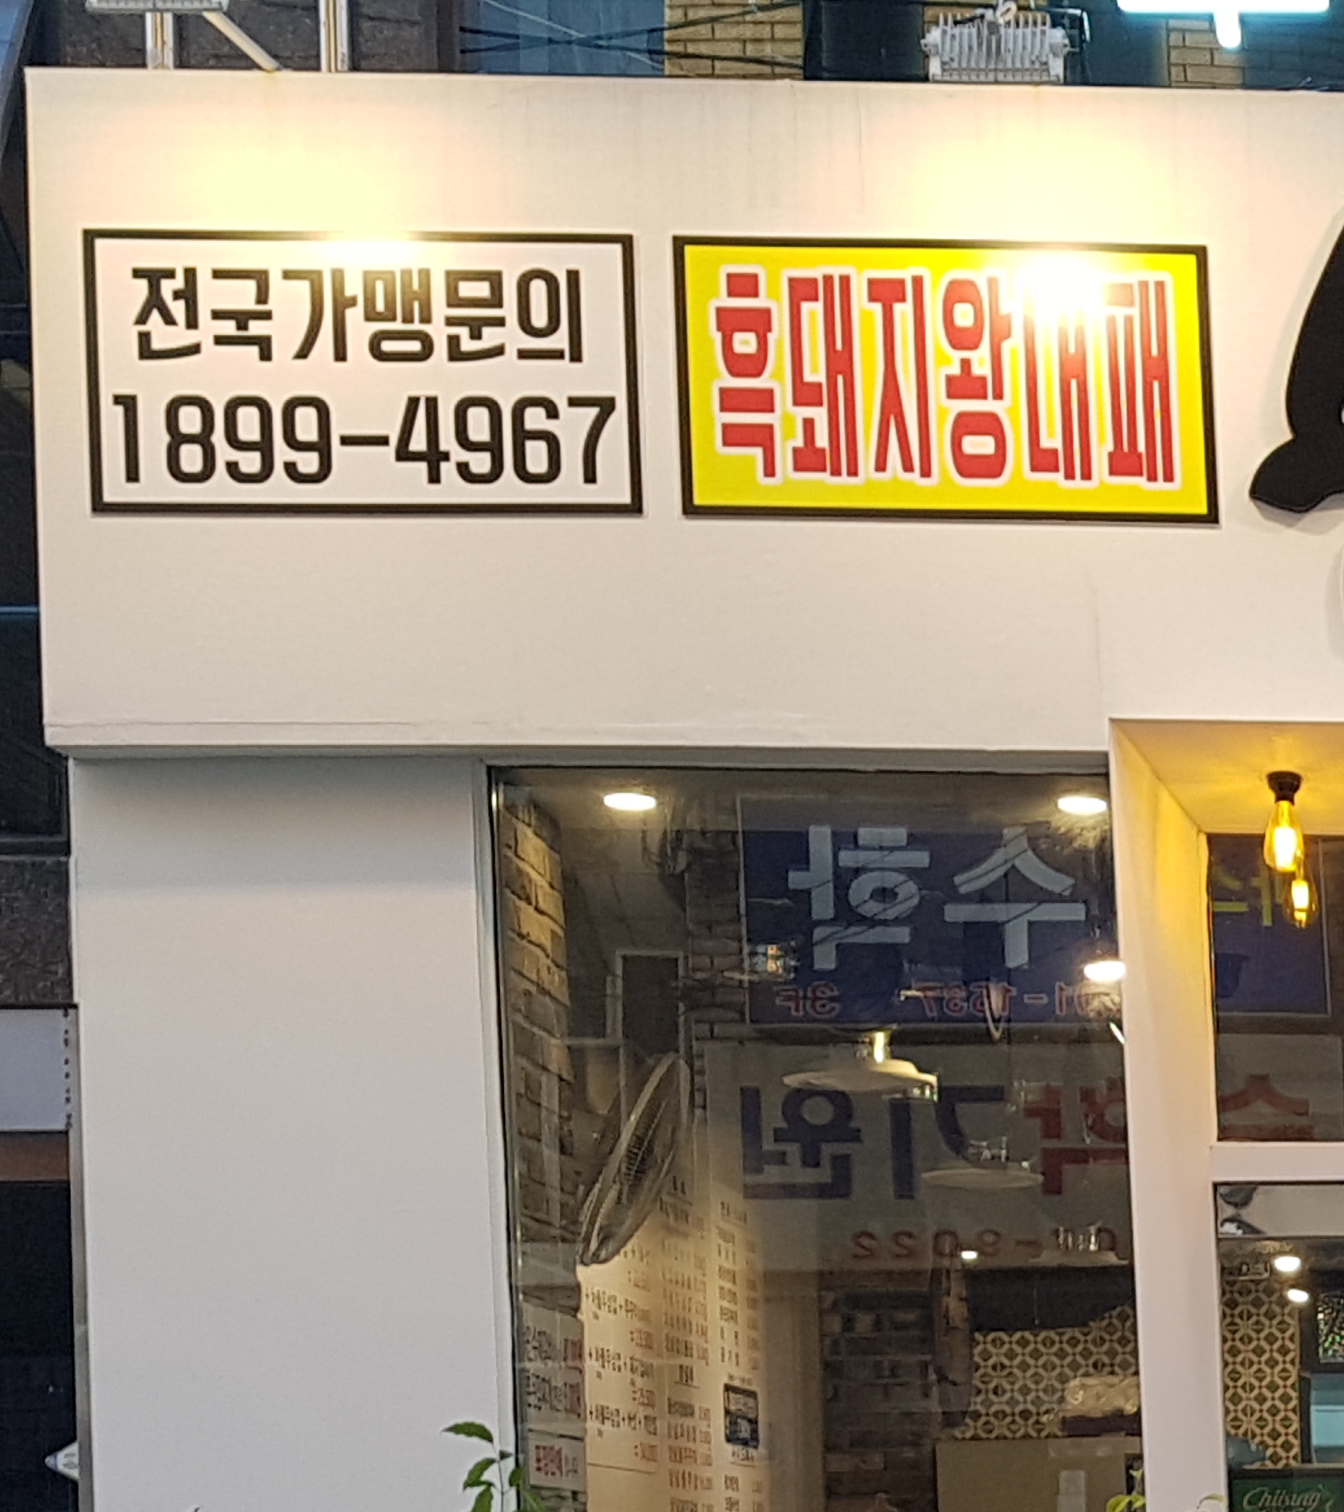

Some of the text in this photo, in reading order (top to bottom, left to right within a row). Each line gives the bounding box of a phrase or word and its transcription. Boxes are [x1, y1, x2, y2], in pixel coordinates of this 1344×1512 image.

[130, 266, 584, 364] 전국가맹문의
[714, 270, 1177, 484] 흑돼지왕대패
[113, 394, 618, 486] 1899-4967
